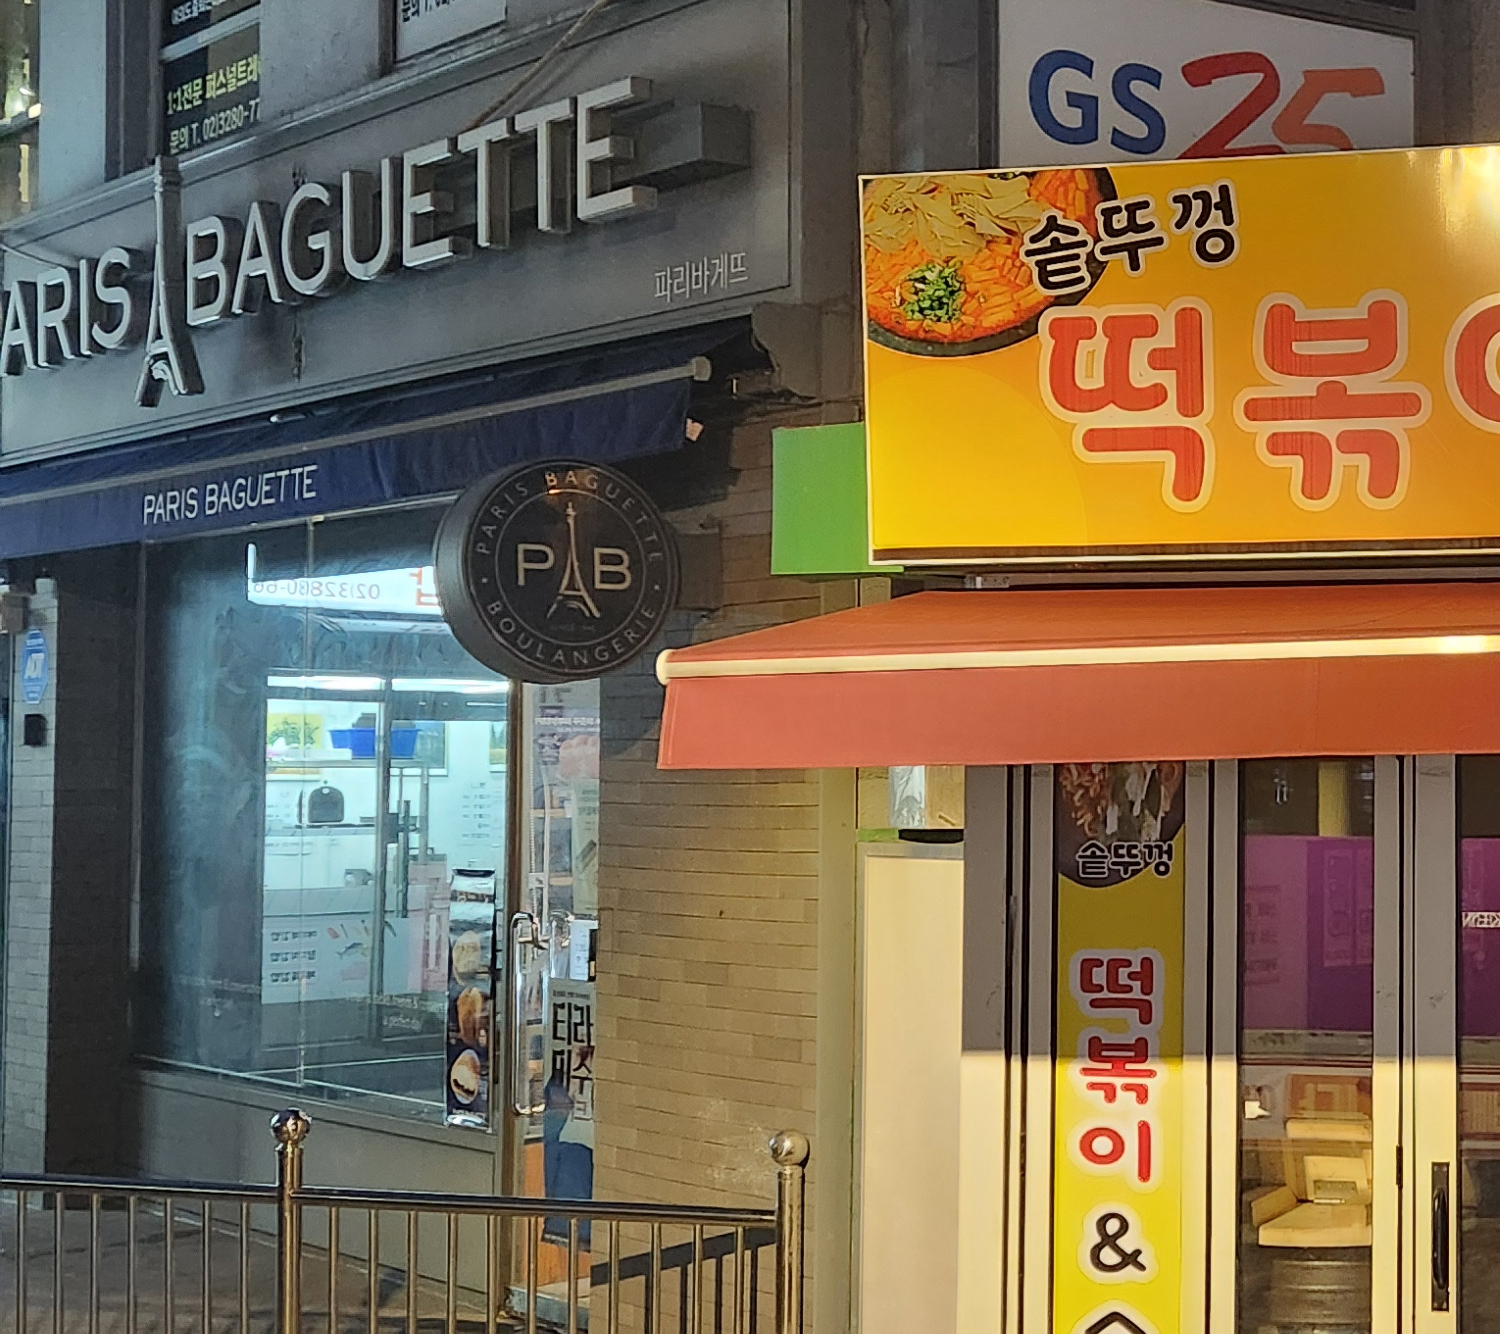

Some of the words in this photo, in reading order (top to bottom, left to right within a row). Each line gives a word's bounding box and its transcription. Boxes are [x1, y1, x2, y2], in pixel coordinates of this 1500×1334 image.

[1027, 48, 1386, 158] GS25
[170, 125, 188, 155] 문의
[186, 76, 657, 329] BAGUETTE
[1026, 181, 1238, 291] 솥뚜껑
[654, 251, 749, 303] 파리바게뜨
[142, 486, 198, 525] PARIS
[205, 465, 318, 519] BAGUETTE
[475, 481, 529, 555] PARIS
[544, 469, 663, 559] BAGUETTE
[516, 543, 555, 586] P
[593, 547, 633, 590] B
[485, 599, 656, 665] BOULANGERIE
[1077, 842, 1174, 878] 솥뚜껑
[1079, 956, 1158, 1183] 떡볶이
[1089, 1211, 1147, 1273] &
